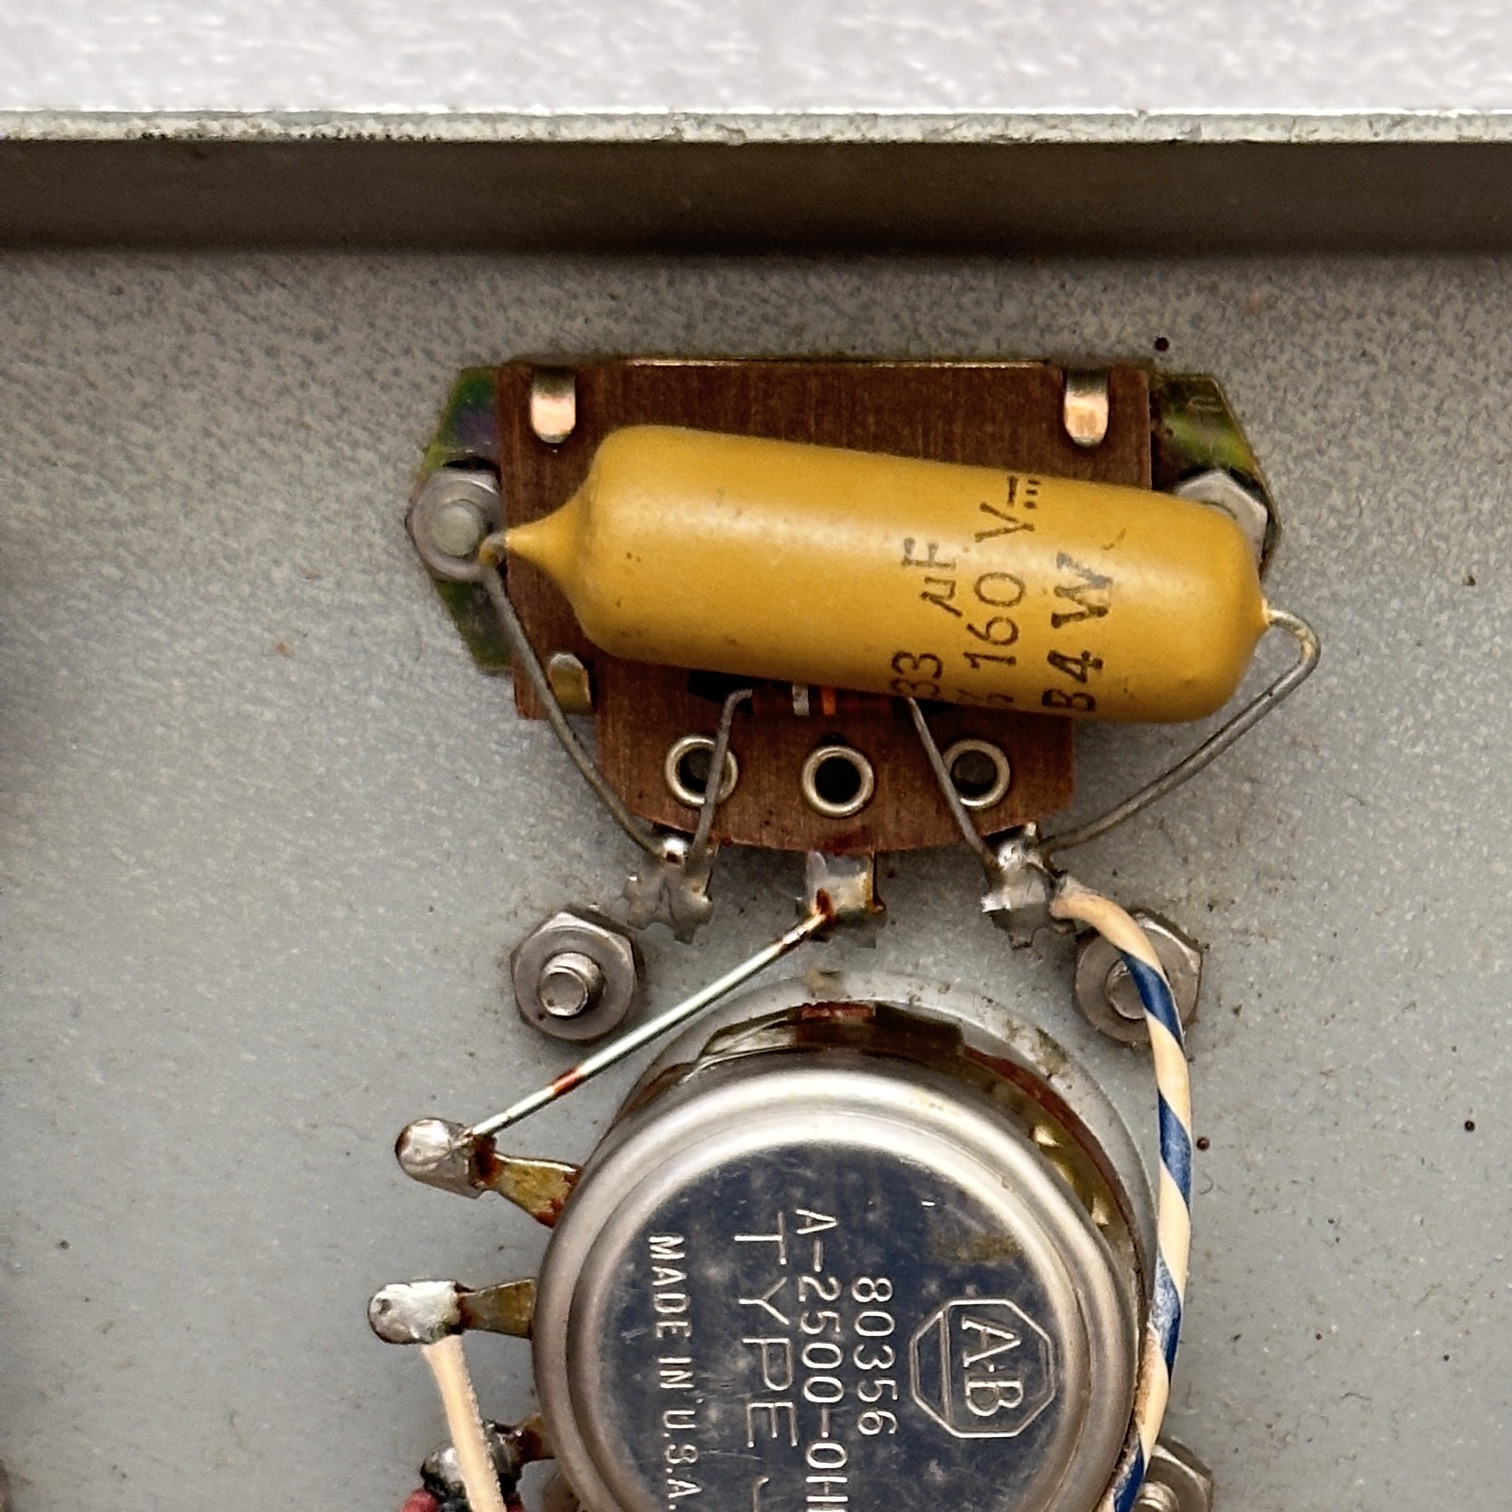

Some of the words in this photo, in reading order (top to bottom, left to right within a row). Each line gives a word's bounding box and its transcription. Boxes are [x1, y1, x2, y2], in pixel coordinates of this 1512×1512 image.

[963, 571, 1026, 670] 160
[649, 1234, 691, 1339] MADE
[733, 1211, 798, 1449] TYPE
[660, 1357, 694, 1389] IN
[851, 1276, 899, 1437] 80356
[663, 1409, 698, 1510] U.S.A.
